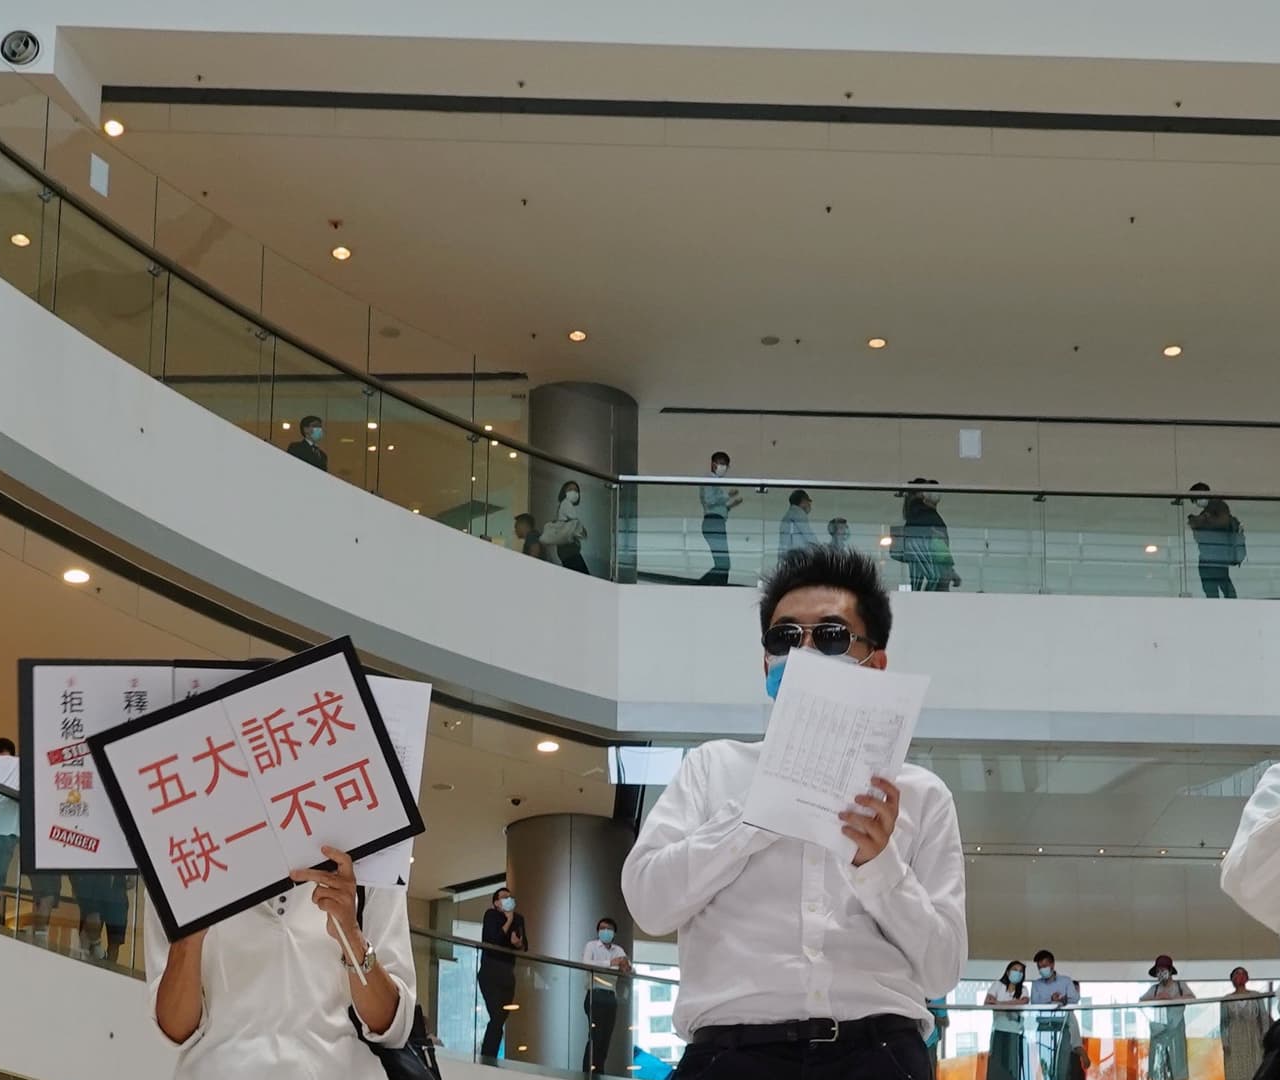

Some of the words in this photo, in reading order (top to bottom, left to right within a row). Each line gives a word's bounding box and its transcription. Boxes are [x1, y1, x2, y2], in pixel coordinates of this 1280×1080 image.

[124, 691, 148, 722] 釋
[139, 690, 356, 814] 五大訴求
[51, 826, 98, 852] DANGER
[169, 758, 379, 888] 缺一不可
